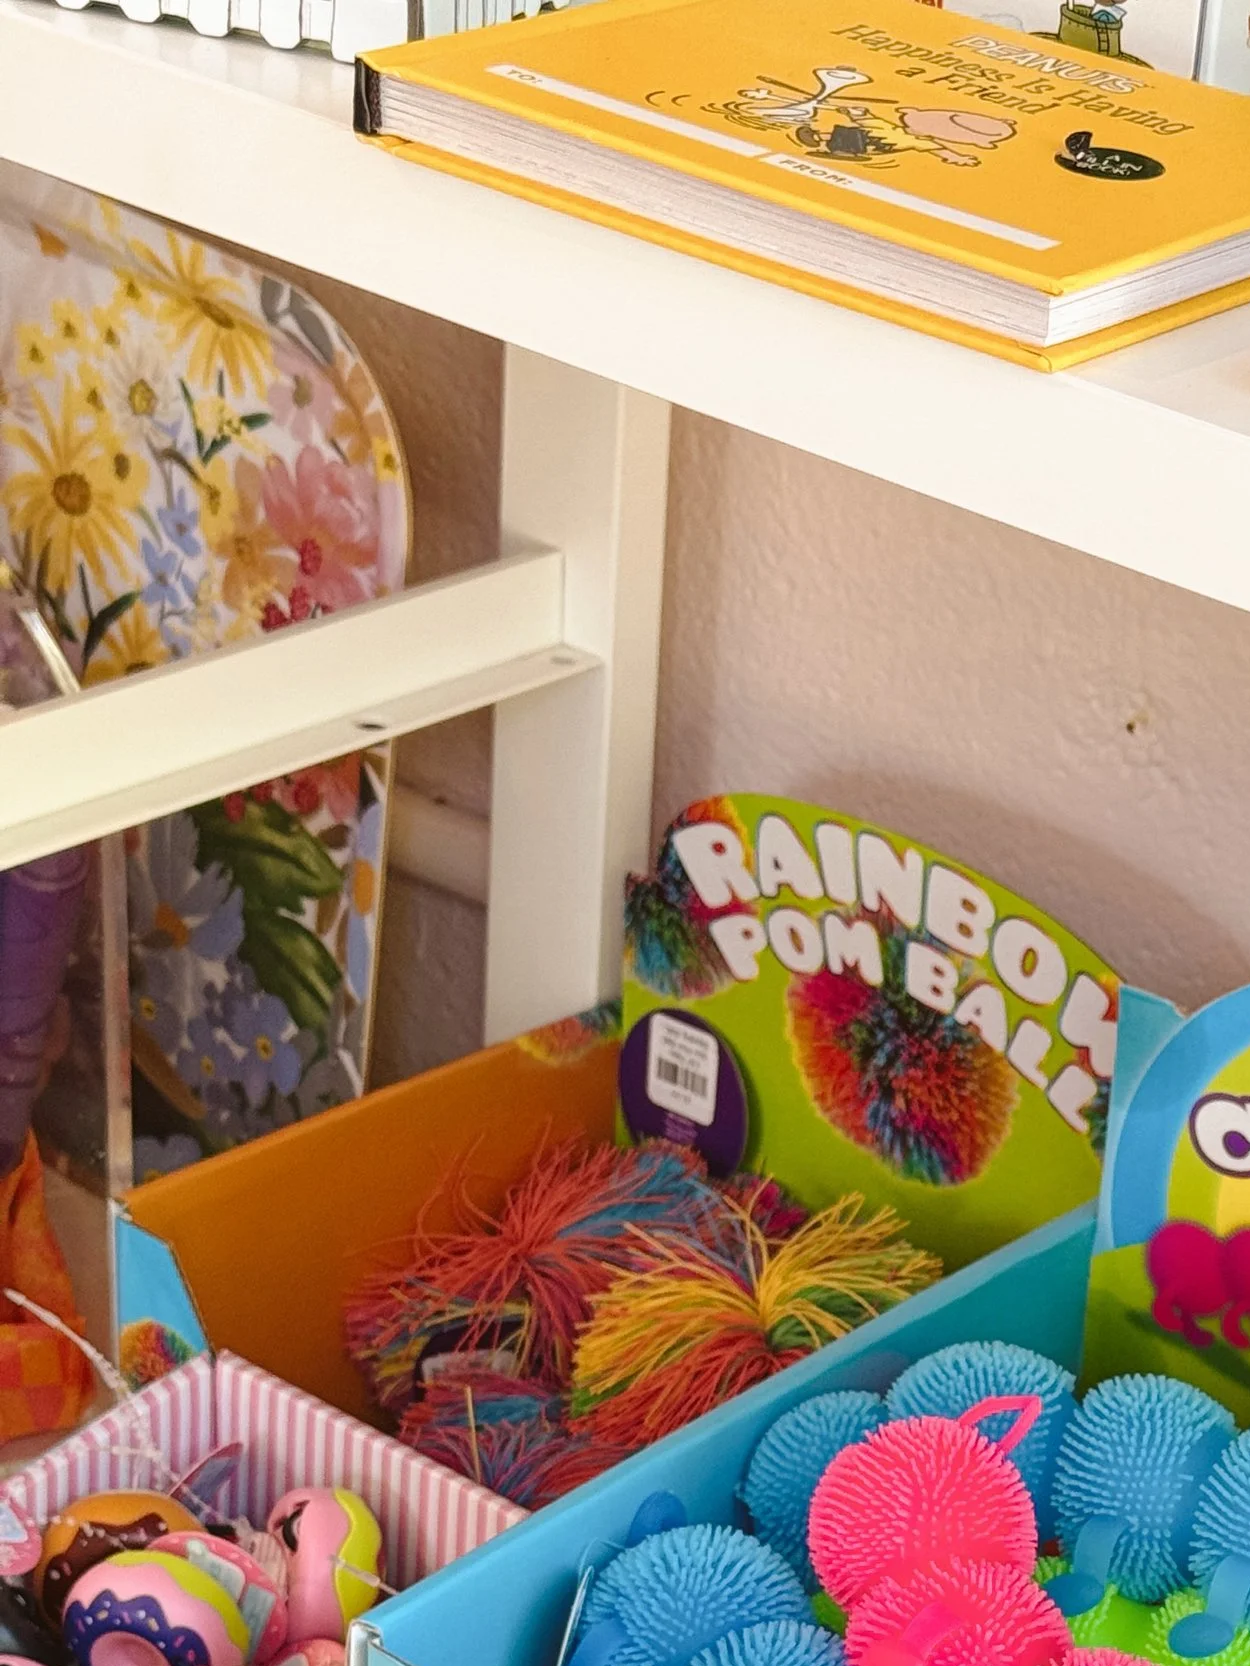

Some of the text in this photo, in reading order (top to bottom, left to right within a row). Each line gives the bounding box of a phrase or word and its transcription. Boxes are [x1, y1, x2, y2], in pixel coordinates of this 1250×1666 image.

[831, 24, 1196, 136] Happiness Is Having
[894, 63, 1062, 116] a Friend
[947, 34, 1146, 95] PEANUTS
[779, 159, 854, 185] FROM:
[709, 908, 1098, 1134] POM BALL
